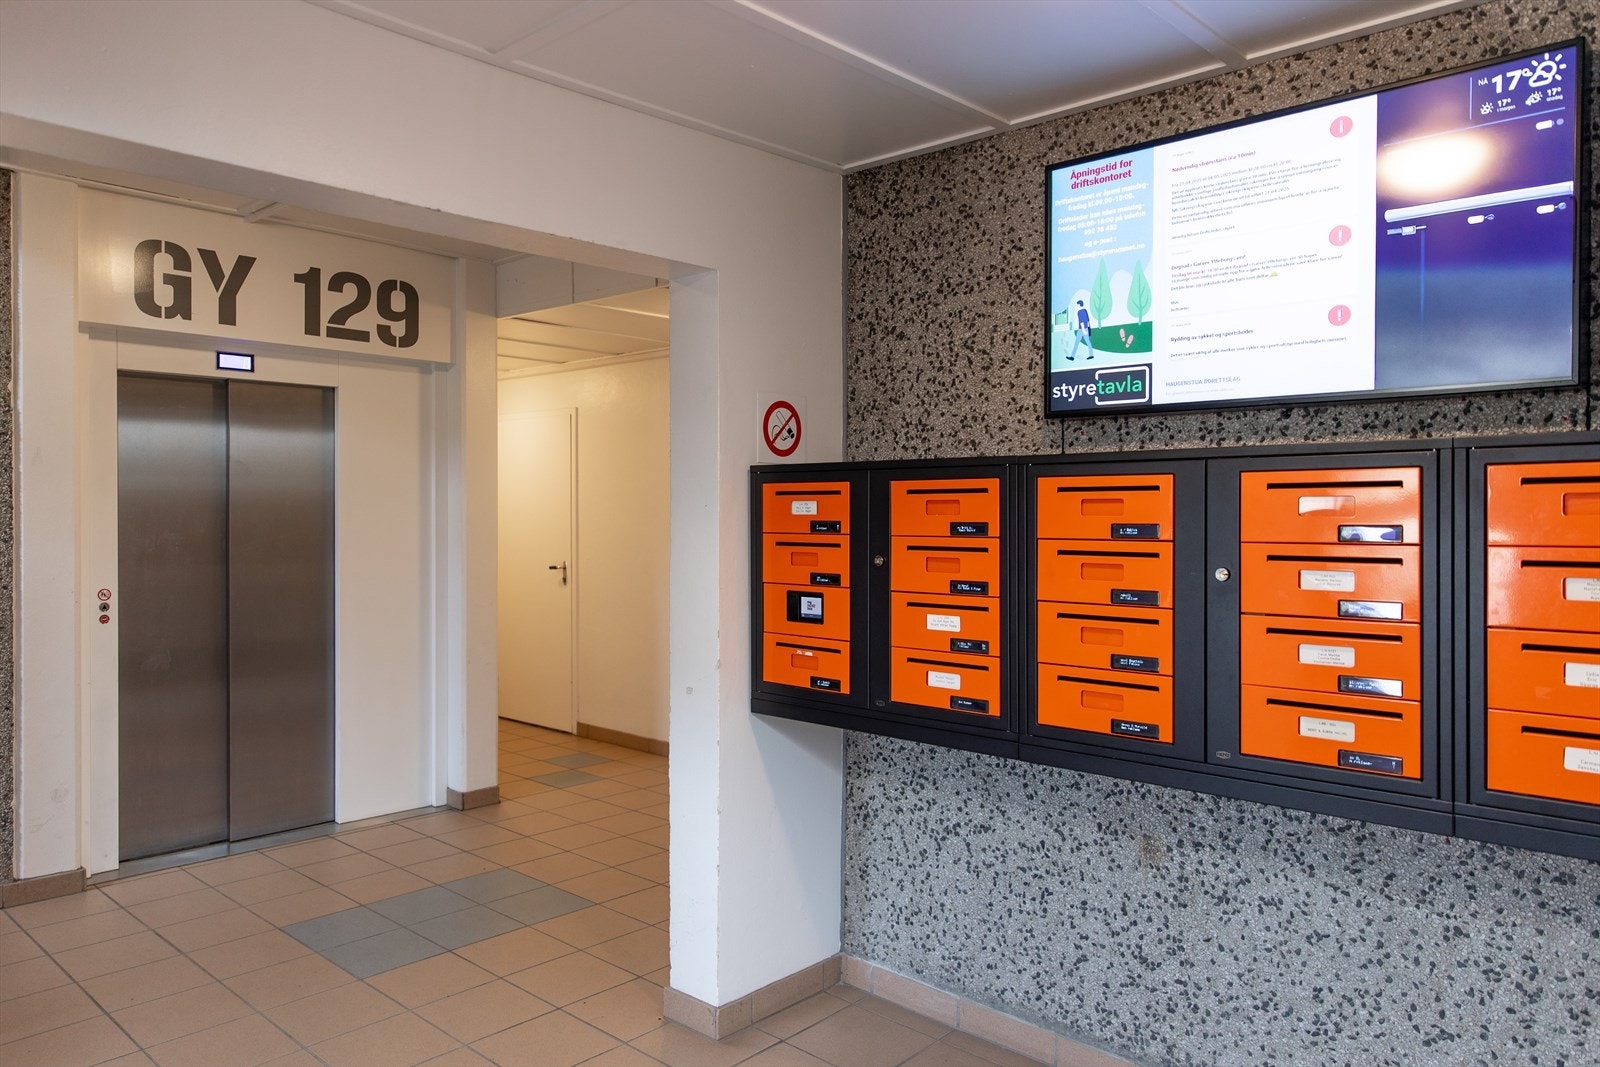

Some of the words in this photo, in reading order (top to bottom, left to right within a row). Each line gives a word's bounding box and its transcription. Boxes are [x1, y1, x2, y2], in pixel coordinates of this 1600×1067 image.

[1070, 162, 1117, 180] Åpningstid
[1120, 159, 1133, 169] for
[1071, 170, 1132, 190] driftskontoret
[134, 239, 257, 326] GY
[294, 267, 419, 349] 129
[1052, 375, 1142, 402] styretavla
